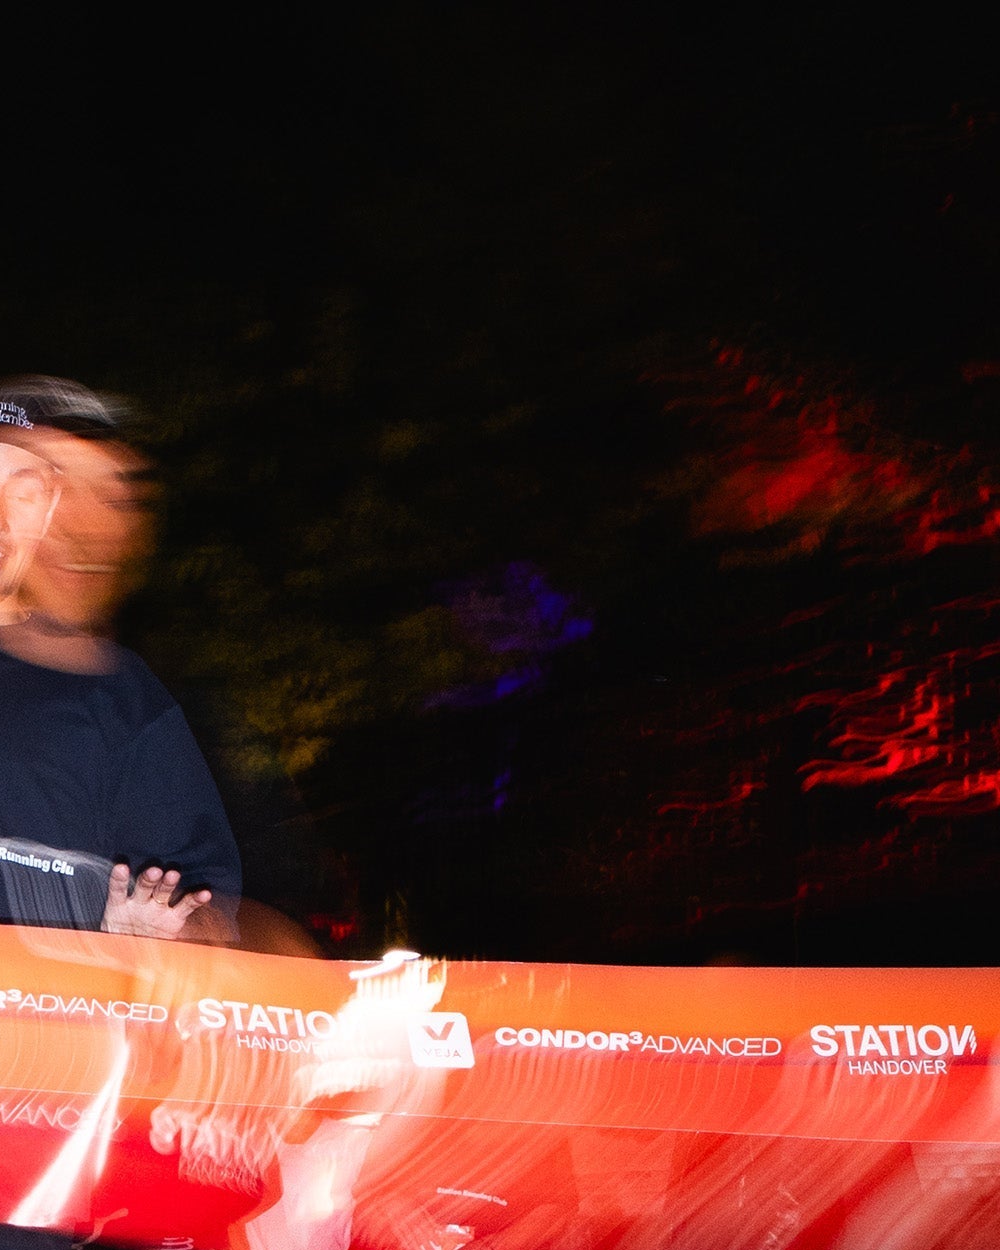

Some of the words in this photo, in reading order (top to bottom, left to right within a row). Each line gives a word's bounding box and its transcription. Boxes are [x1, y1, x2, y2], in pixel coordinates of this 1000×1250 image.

[51, 859, 74, 876] Clu
[197, 997, 350, 1040] STATIO
[422, 1047, 462, 1058] VEJA
[848, 1059, 947, 1076] HANDOVER
